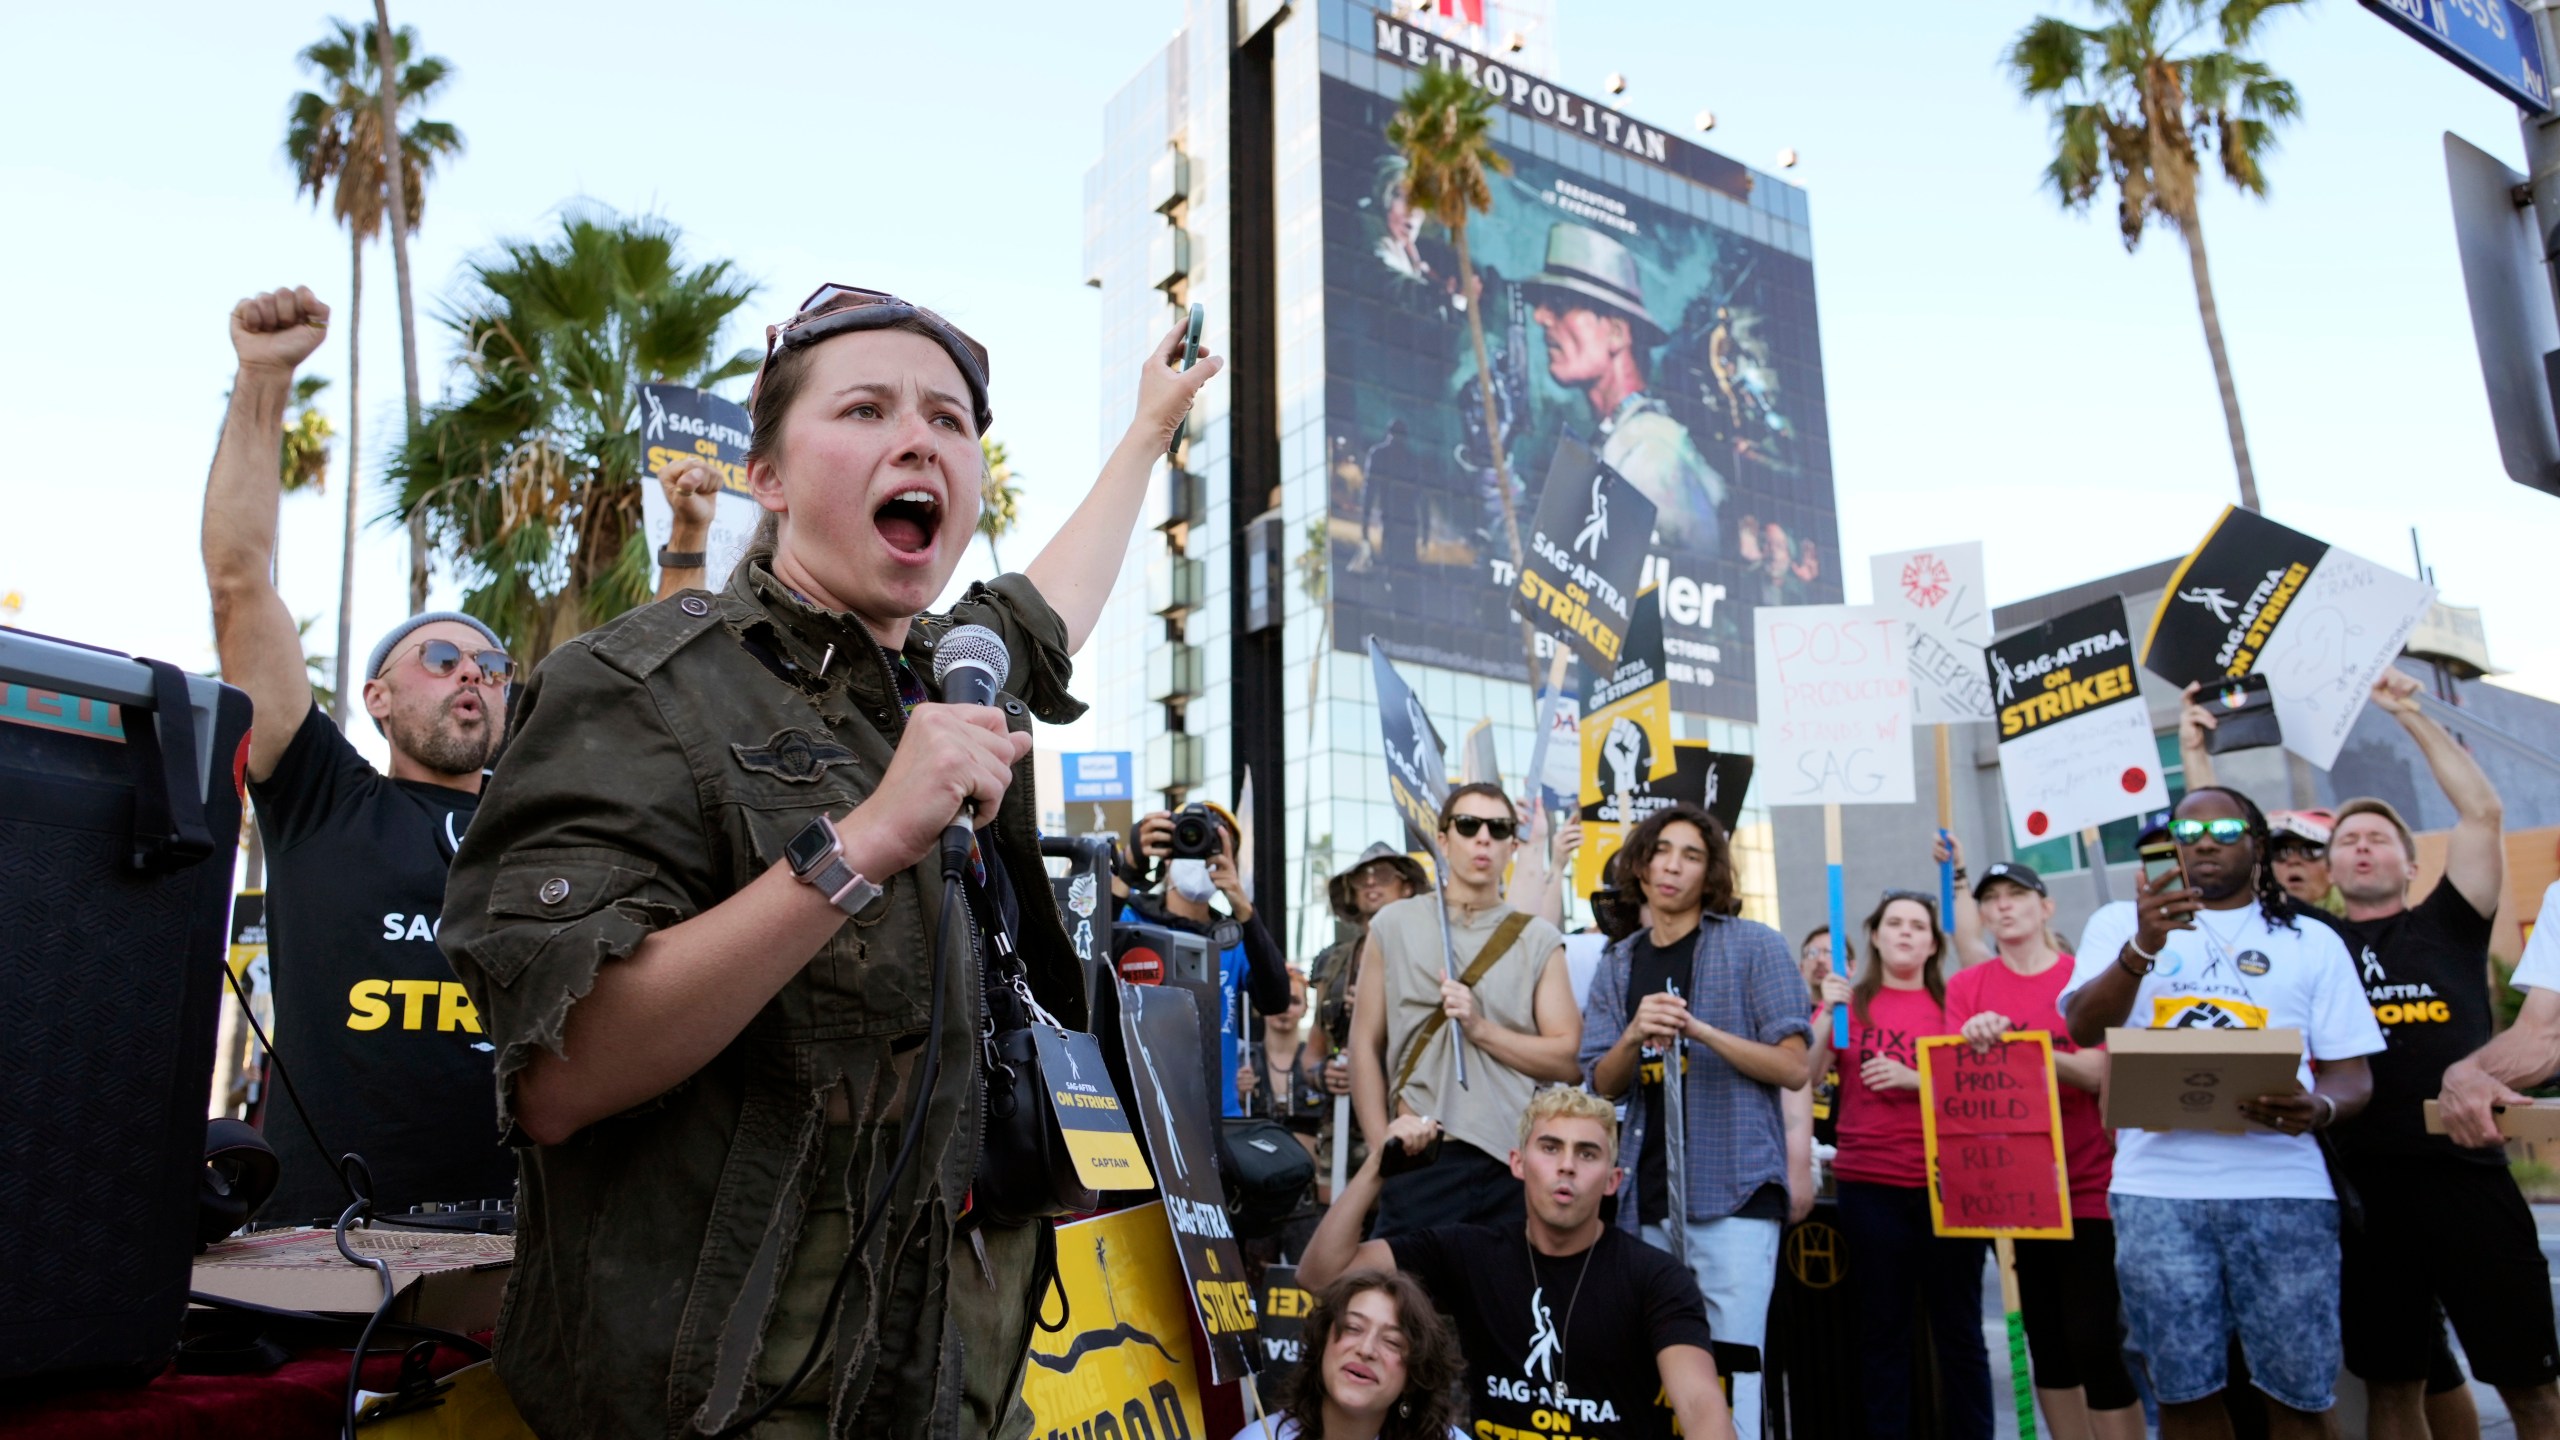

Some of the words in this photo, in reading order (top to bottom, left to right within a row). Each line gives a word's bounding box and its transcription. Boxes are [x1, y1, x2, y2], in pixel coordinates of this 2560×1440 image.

[1376, 19, 1667, 163] METROPOLITAN
[695, 439, 718, 456] ON
[1565, 583, 1590, 607] ON
[1519, 569, 1621, 661] STRIKE!
[2226, 648, 2254, 678] ON
[2244, 561, 2310, 652] STRIKE!
[1769, 619, 1899, 684] POST
[2043, 667, 2072, 689] ON
[2001, 664, 2133, 736] STRIKE!
[1792, 747, 1887, 796] SAG
[1860, 1028, 1906, 1051] FIX
[1956, 1045, 2009, 1067] POST
[1954, 1071, 2023, 1092] PROD.
[1056, 1091, 1075, 1107] ON
[1075, 1094, 1119, 1111] STRIKE!
[1943, 1098, 2029, 1120] GUILD
[1091, 1157, 1130, 1168] CAPTAIN
[1205, 1248, 1222, 1274] ON
[1197, 1279, 1257, 1335] STRIKE!
[1531, 1409, 1571, 1433] ON
